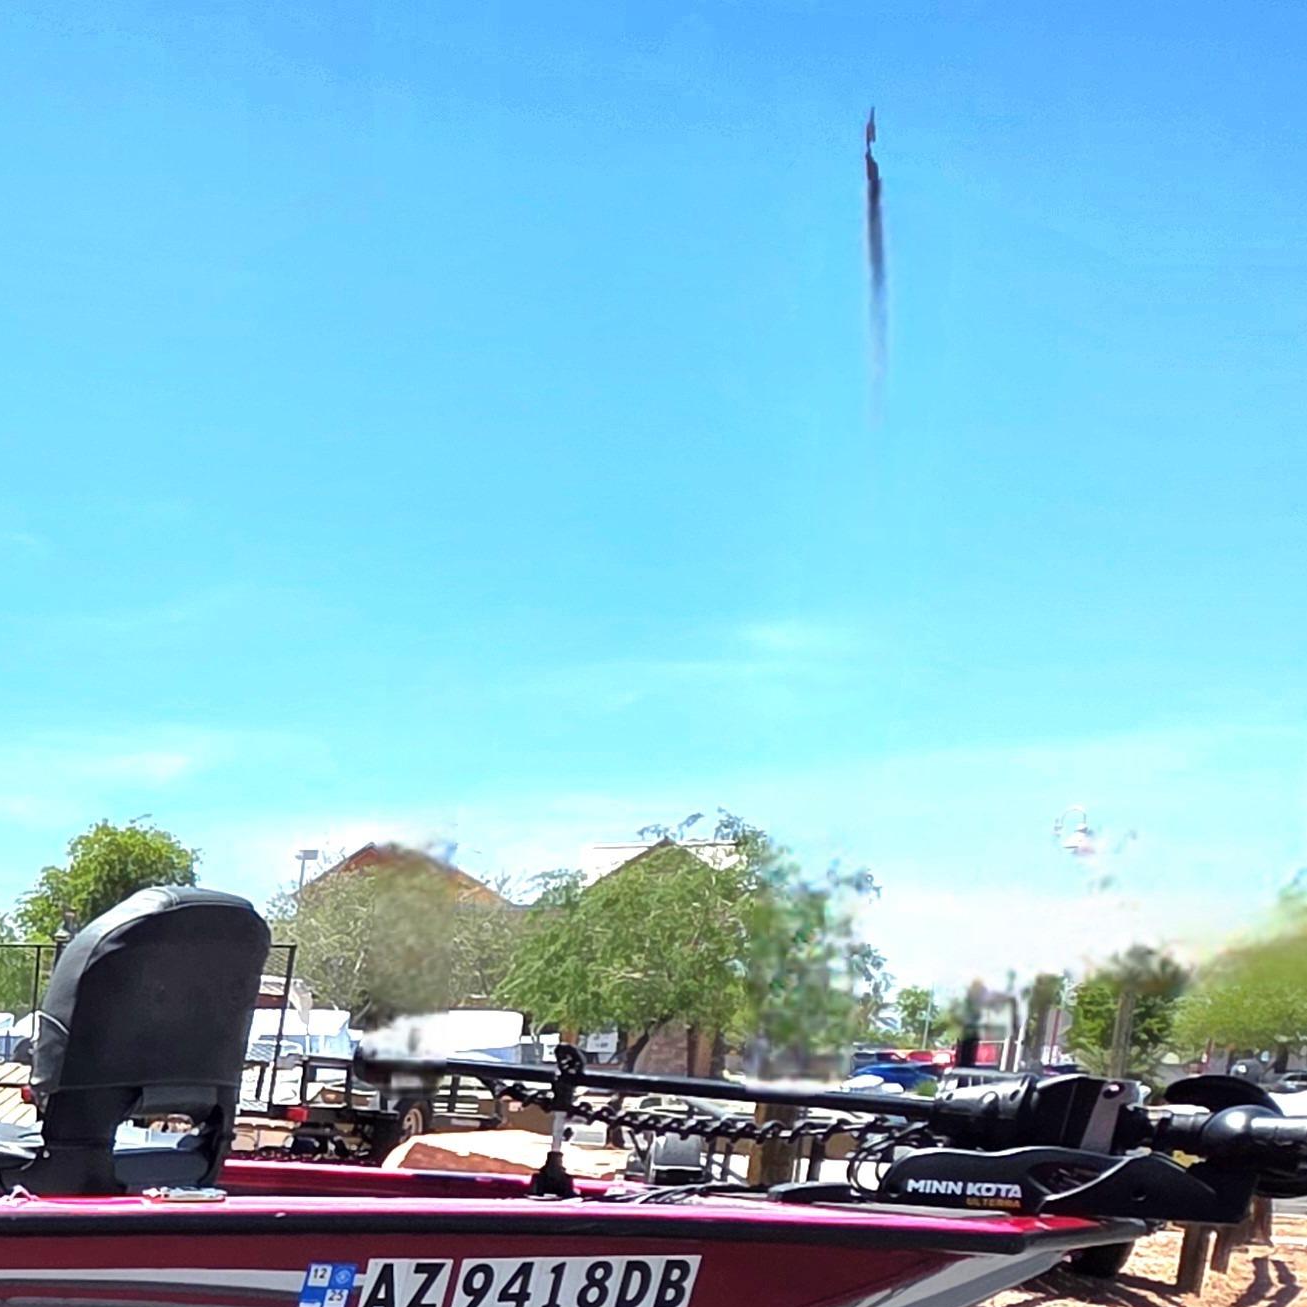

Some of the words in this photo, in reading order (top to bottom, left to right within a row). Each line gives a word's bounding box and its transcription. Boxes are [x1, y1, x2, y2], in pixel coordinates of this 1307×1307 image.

[906, 1178, 964, 1195] MINN
[966, 1182, 1023, 1198] KOTA
[313, 1267, 328, 1279] 12
